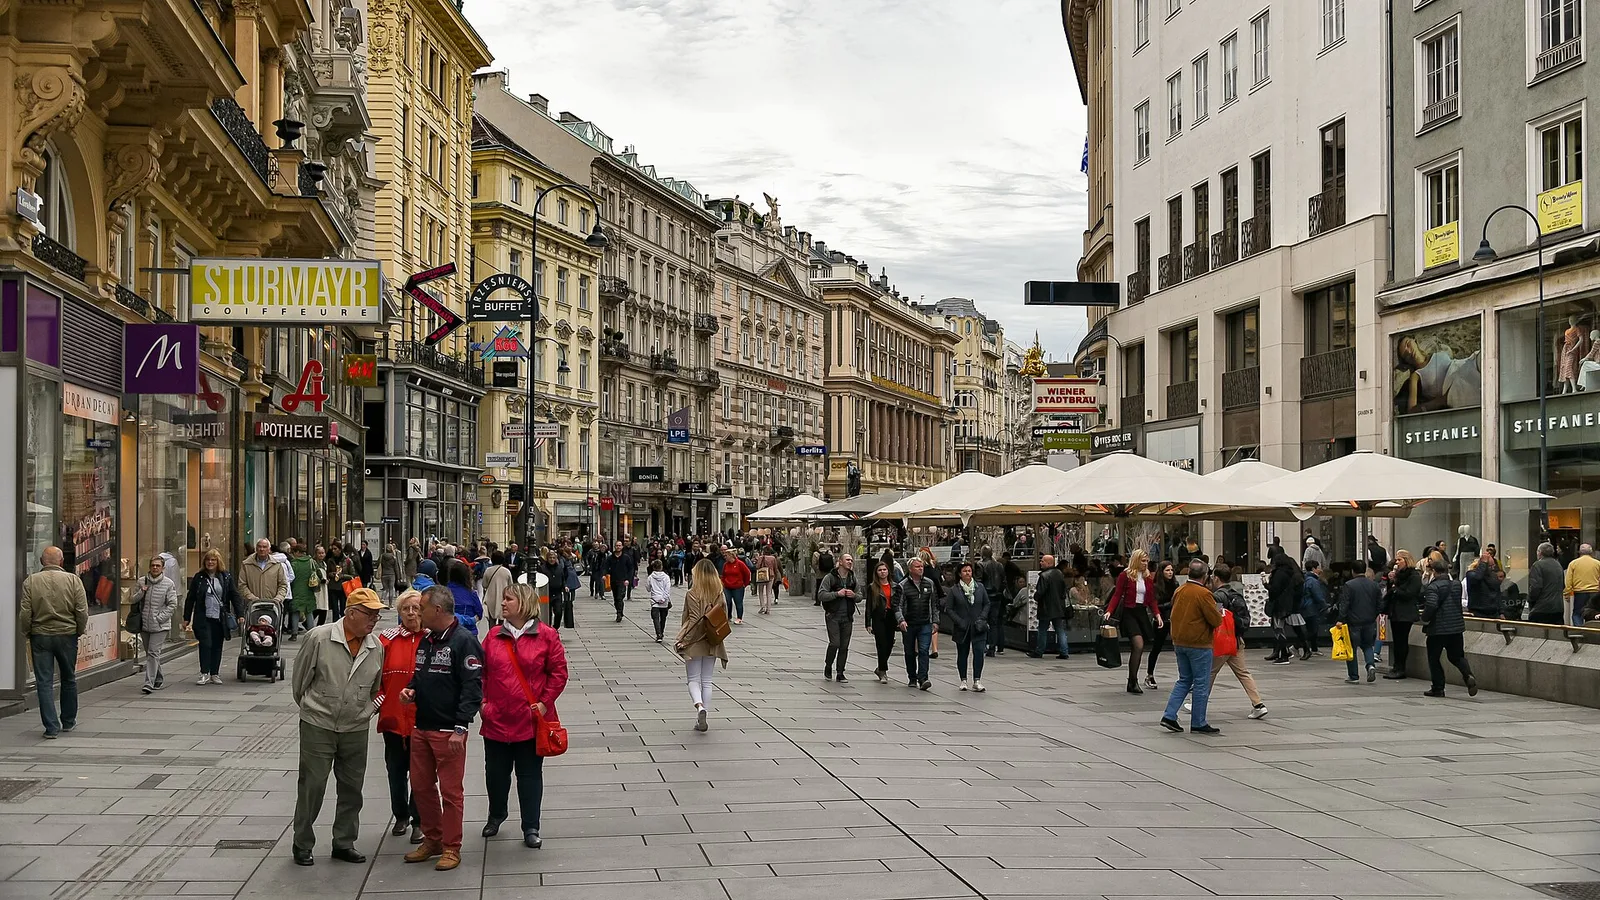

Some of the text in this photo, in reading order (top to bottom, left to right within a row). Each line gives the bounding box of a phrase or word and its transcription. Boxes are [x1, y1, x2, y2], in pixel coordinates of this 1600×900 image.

[204, 265, 367, 307] STURMAYR
[484, 302, 523, 311] BUFFET
[203, 307, 367, 317] COIFFEURE
[1047, 387, 1086, 396] WIENER
[65, 391, 115, 416] URBAN DECAY
[1037, 396, 1096, 404] STADTBRÄU
[260, 422, 324, 439] APOTHEKE
[670, 430, 686, 438] LPE
[1405, 426, 1478, 444] STEFANEL
